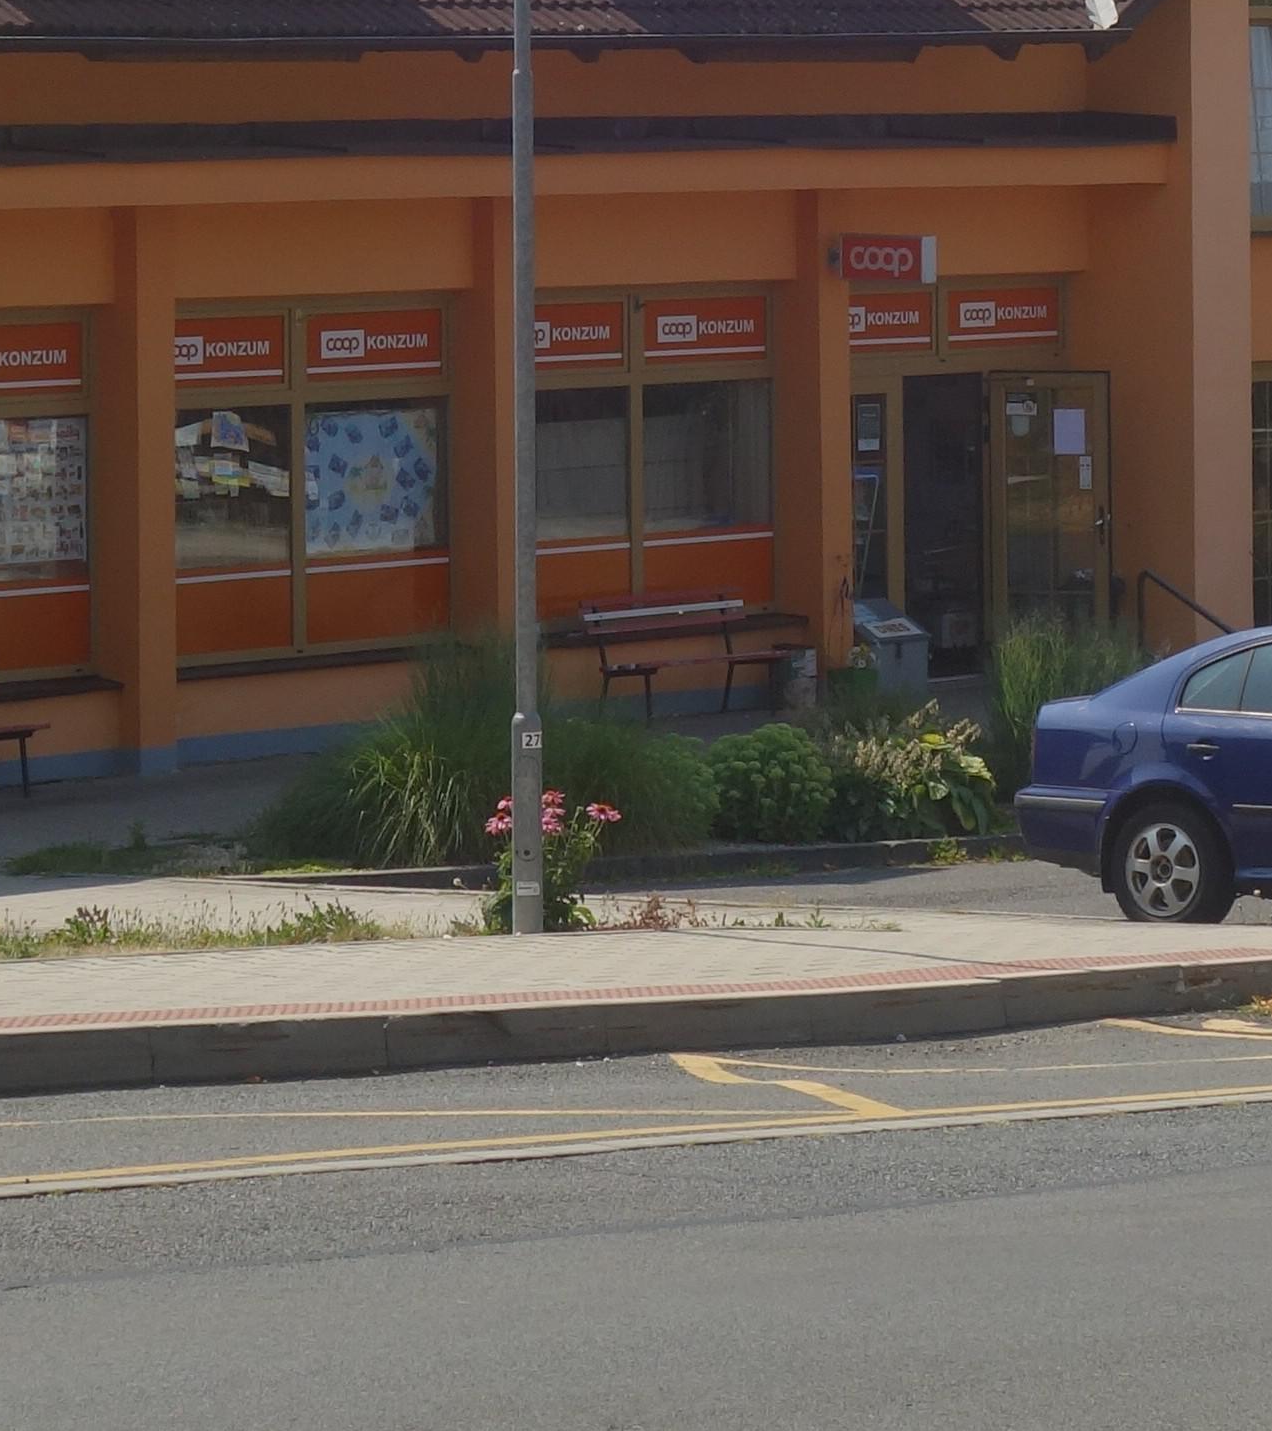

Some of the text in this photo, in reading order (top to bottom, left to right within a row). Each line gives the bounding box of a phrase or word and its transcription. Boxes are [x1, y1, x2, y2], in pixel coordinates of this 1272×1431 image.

[850, 244, 915, 278] coop
[867, 310, 920, 326] KONZUM
[963, 304, 1048, 325] coop KONZUM
[552, 325, 610, 342] KONZUM
[662, 318, 755, 340] coop KONZUM
[206, 340, 270, 357] KONZUM
[325, 333, 428, 355] coop KONZUM
[525, 734, 540, 747] 27
